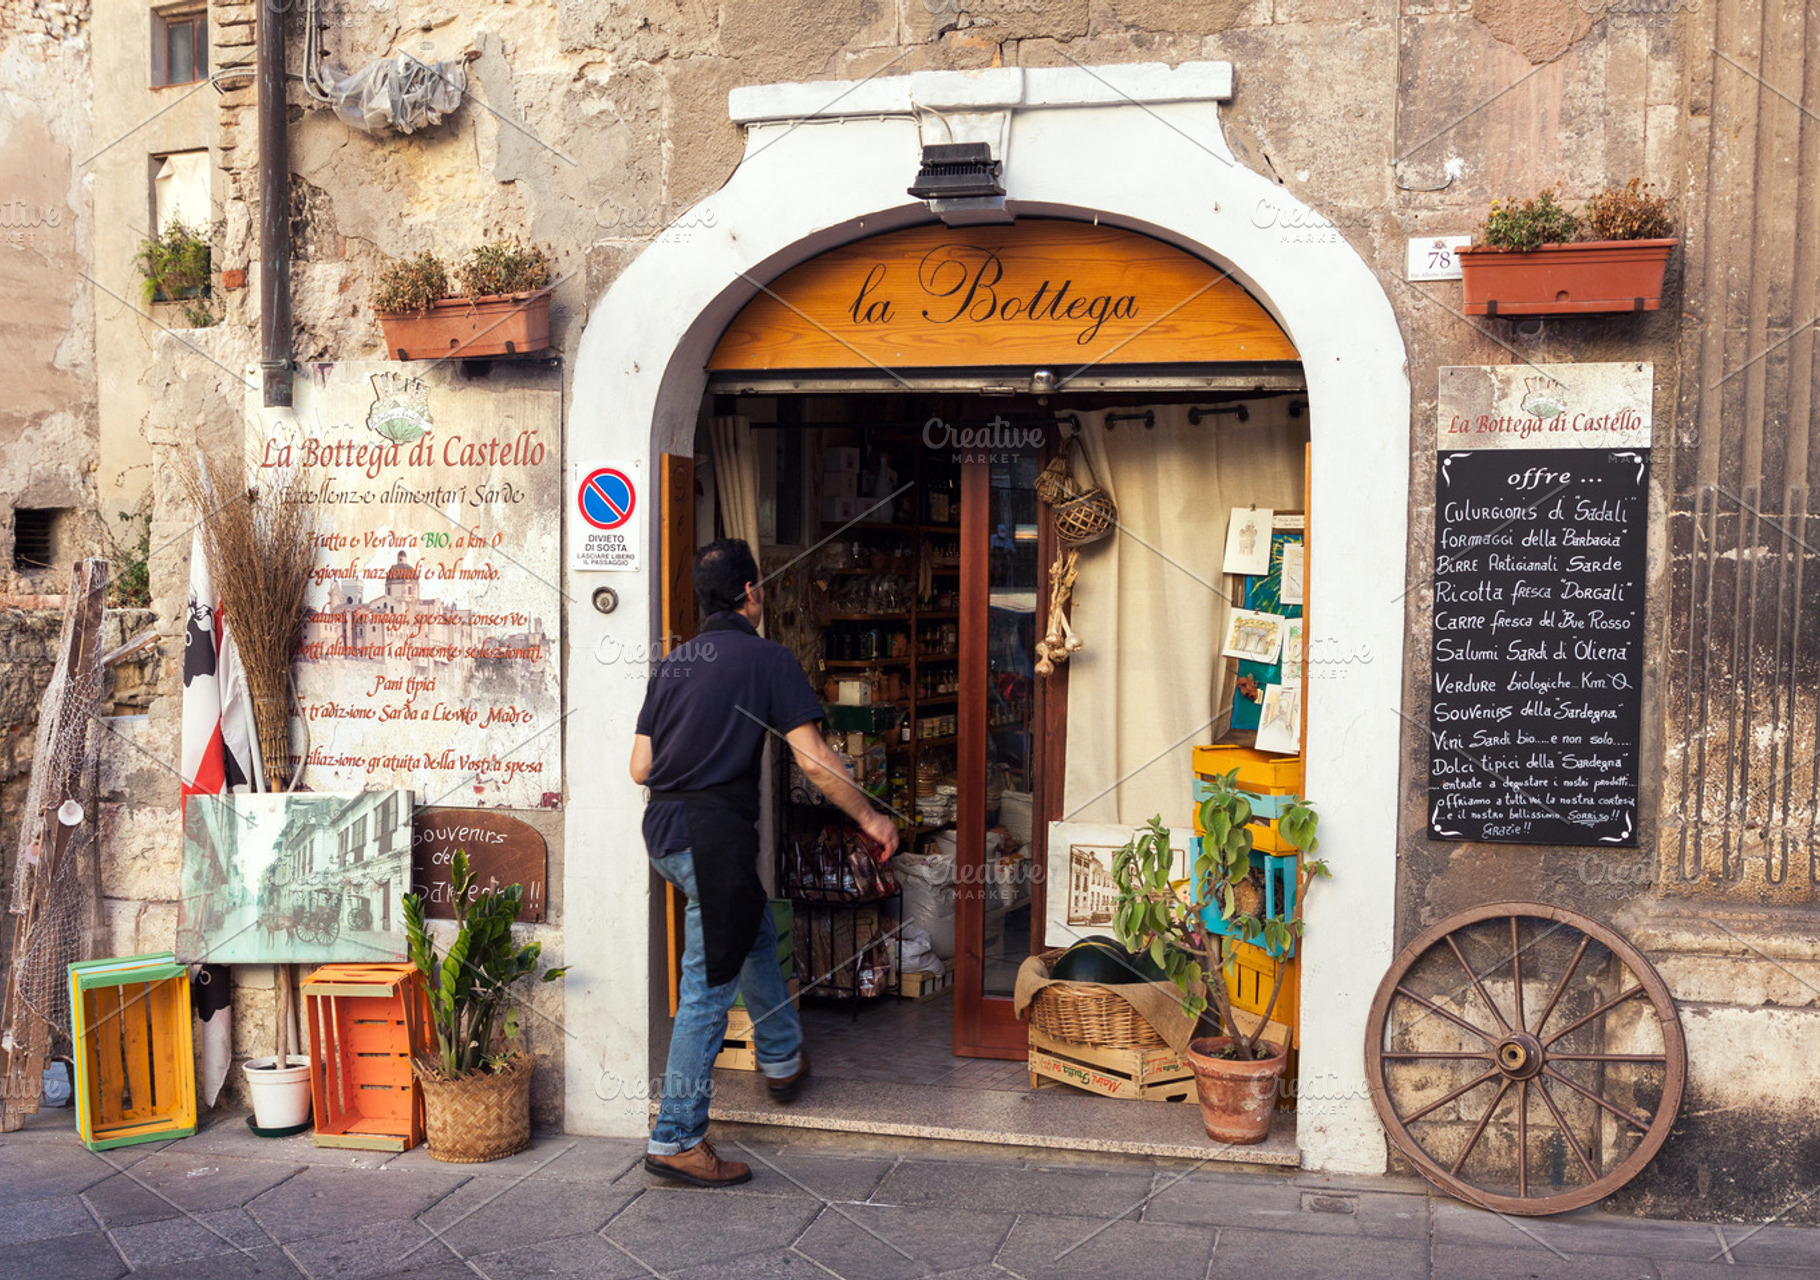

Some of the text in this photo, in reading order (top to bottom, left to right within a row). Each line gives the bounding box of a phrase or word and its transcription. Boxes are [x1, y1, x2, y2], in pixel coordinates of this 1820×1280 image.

[1428, 251, 1451, 269] 78
[917, 243, 1139, 345] Bottega
[1448, 409, 1642, 439] La Bottega di Castello
[261, 430, 546, 479] La Bottega di Castello
[1507, 467, 1571, 490] offre
[380, 477, 466, 507] alimentari
[469, 481, 525, 507] Sarde
[1548, 495, 1565, 520] di
[350, 536, 360, 548] e
[364, 530, 418, 549] Verdura
[456, 536, 465, 548] a
[468, 525, 487, 548] km
[585, 543, 627, 552] DI SOSTA
[588, 534, 625, 543] DIVIETO
[1521, 528, 1557, 547] della
[577, 552, 609, 560] LASCIARE
[308, 557, 360, 586] egionali,
[363, 557, 426, 579] nazionali
[438, 557, 464, 580] dal
[1435, 580, 1503, 603] Ricotta
[469, 612, 527, 626] conserve
[1539, 609, 1555, 628] del
[326, 633, 393, 660] alimentari
[394, 635, 462, 661] altamente
[1436, 638, 1499, 662] Salumi
[1553, 640, 1567, 660] di
[367, 675, 435, 704] Pani tipici
[310, 701, 376, 721] tradizione
[378, 703, 419, 722] Sarda
[421, 709, 428, 721] a
[432, 702, 478, 723] Lievito
[479, 706, 534, 728] Madre
[1520, 699, 1551, 717] della
[1432, 729, 1463, 750] Vini
[1562, 735, 1582, 744] non
[366, 753, 420, 774] gratuita
[423, 747, 455, 770] della
[458, 754, 501, 774] Vostra
[503, 757, 543, 783] spesa
[1432, 757, 1474, 776] Dolci
[1481, 754, 1520, 774] tipici
[1526, 752, 1554, 768] della
[1489, 780, 1496, 788] a
[1503, 775, 1548, 793] degustare
[1563, 775, 1588, 787] nostri
[1496, 797, 1502, 806] a
[1505, 792, 1527, 805] tutti
[1546, 792, 1556, 804] la
[1560, 792, 1595, 805] nostra
[1458, 808, 1466, 819] il
[1471, 808, 1504, 819] nostro
[1509, 807, 1560, 820] bellissimo
